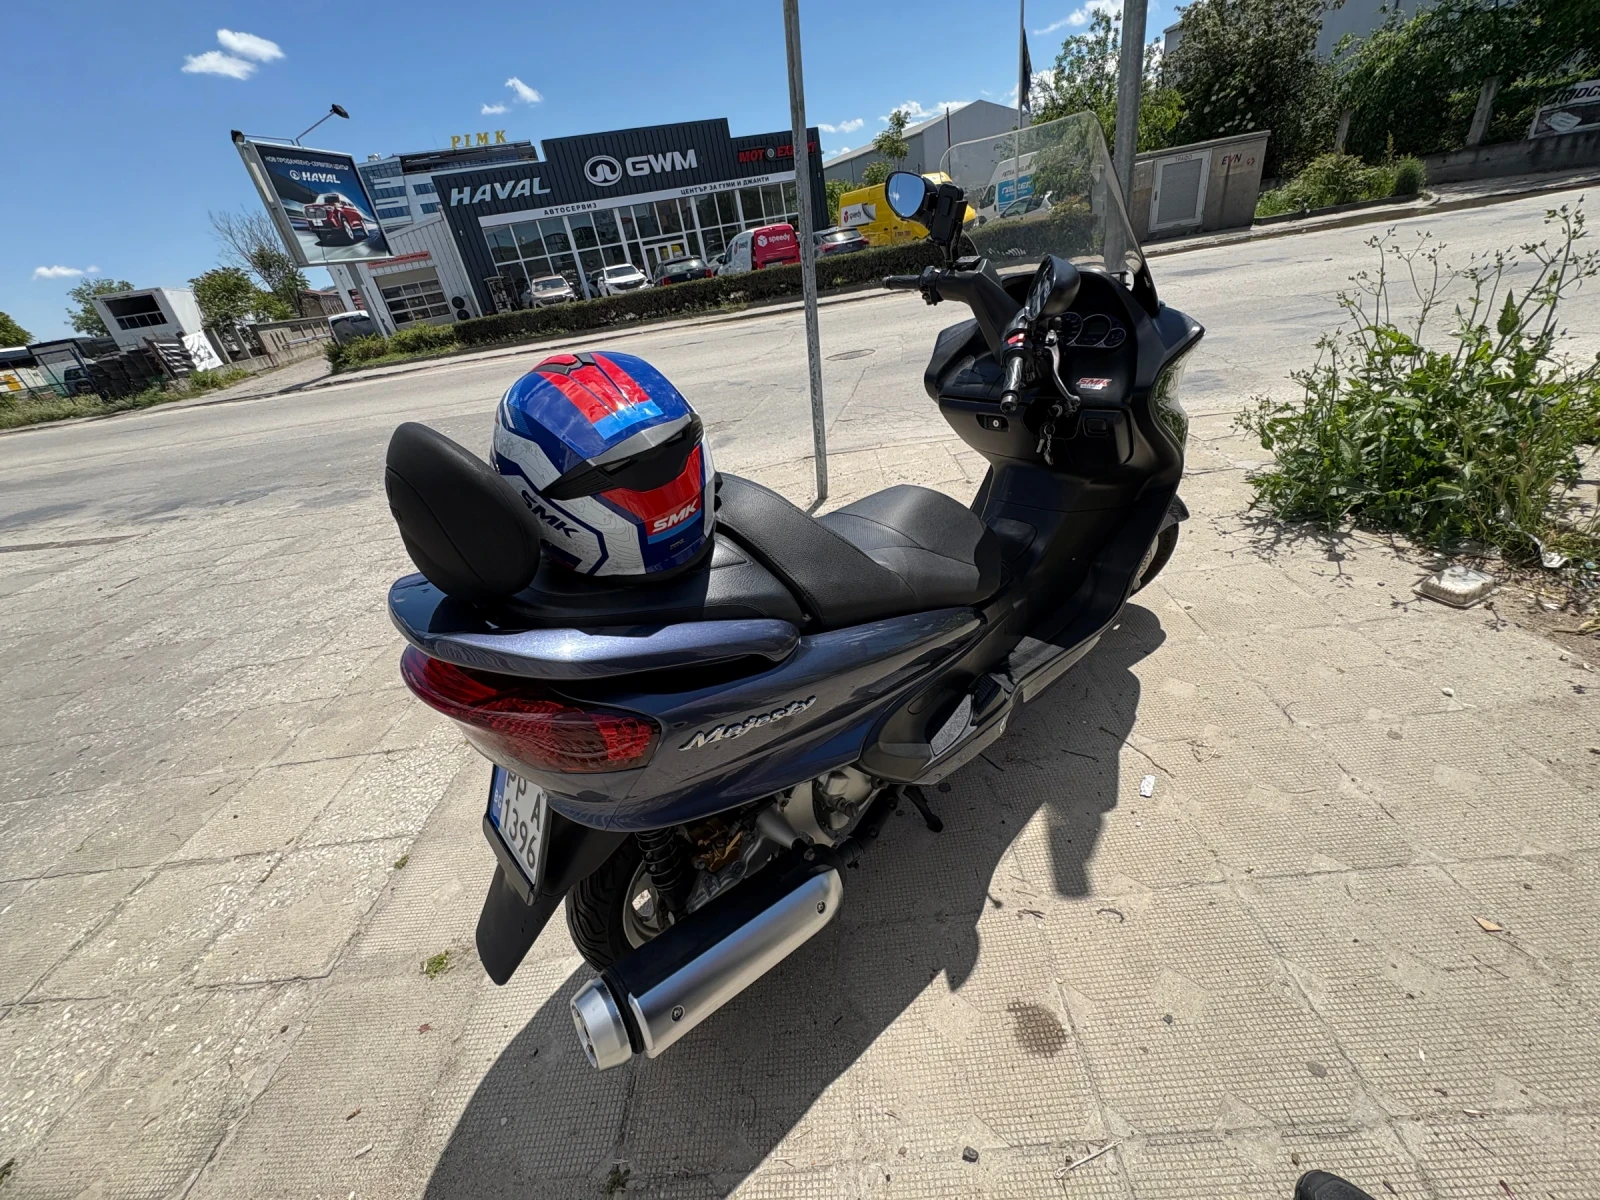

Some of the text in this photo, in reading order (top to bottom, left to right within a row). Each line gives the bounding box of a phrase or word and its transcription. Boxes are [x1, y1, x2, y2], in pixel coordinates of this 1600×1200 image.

[451, 130, 506, 149] PIMK
[625, 149, 698, 177] GWM
[1221, 153, 1242, 165] EVN
[302, 171, 341, 184] HAVAL
[680, 185, 708, 195] ЦЕНТЪР
[719, 181, 736, 189] ГУМИ
[743, 176, 770, 186] ДЖАНТИ
[450, 177, 551, 207] HAVAL
[543, 202, 598, 216] АВТОСЕРВИЗ
[768, 233, 791, 243] speedy
[1079, 378, 1109, 386] SMK
[521, 489, 579, 539] SMK
[652, 498, 698, 533] SMK
[678, 695, 817, 751] Majesty
[493, 788, 503, 810] BG
[530, 791, 541, 833] A
[503, 798, 537, 870] 1396
